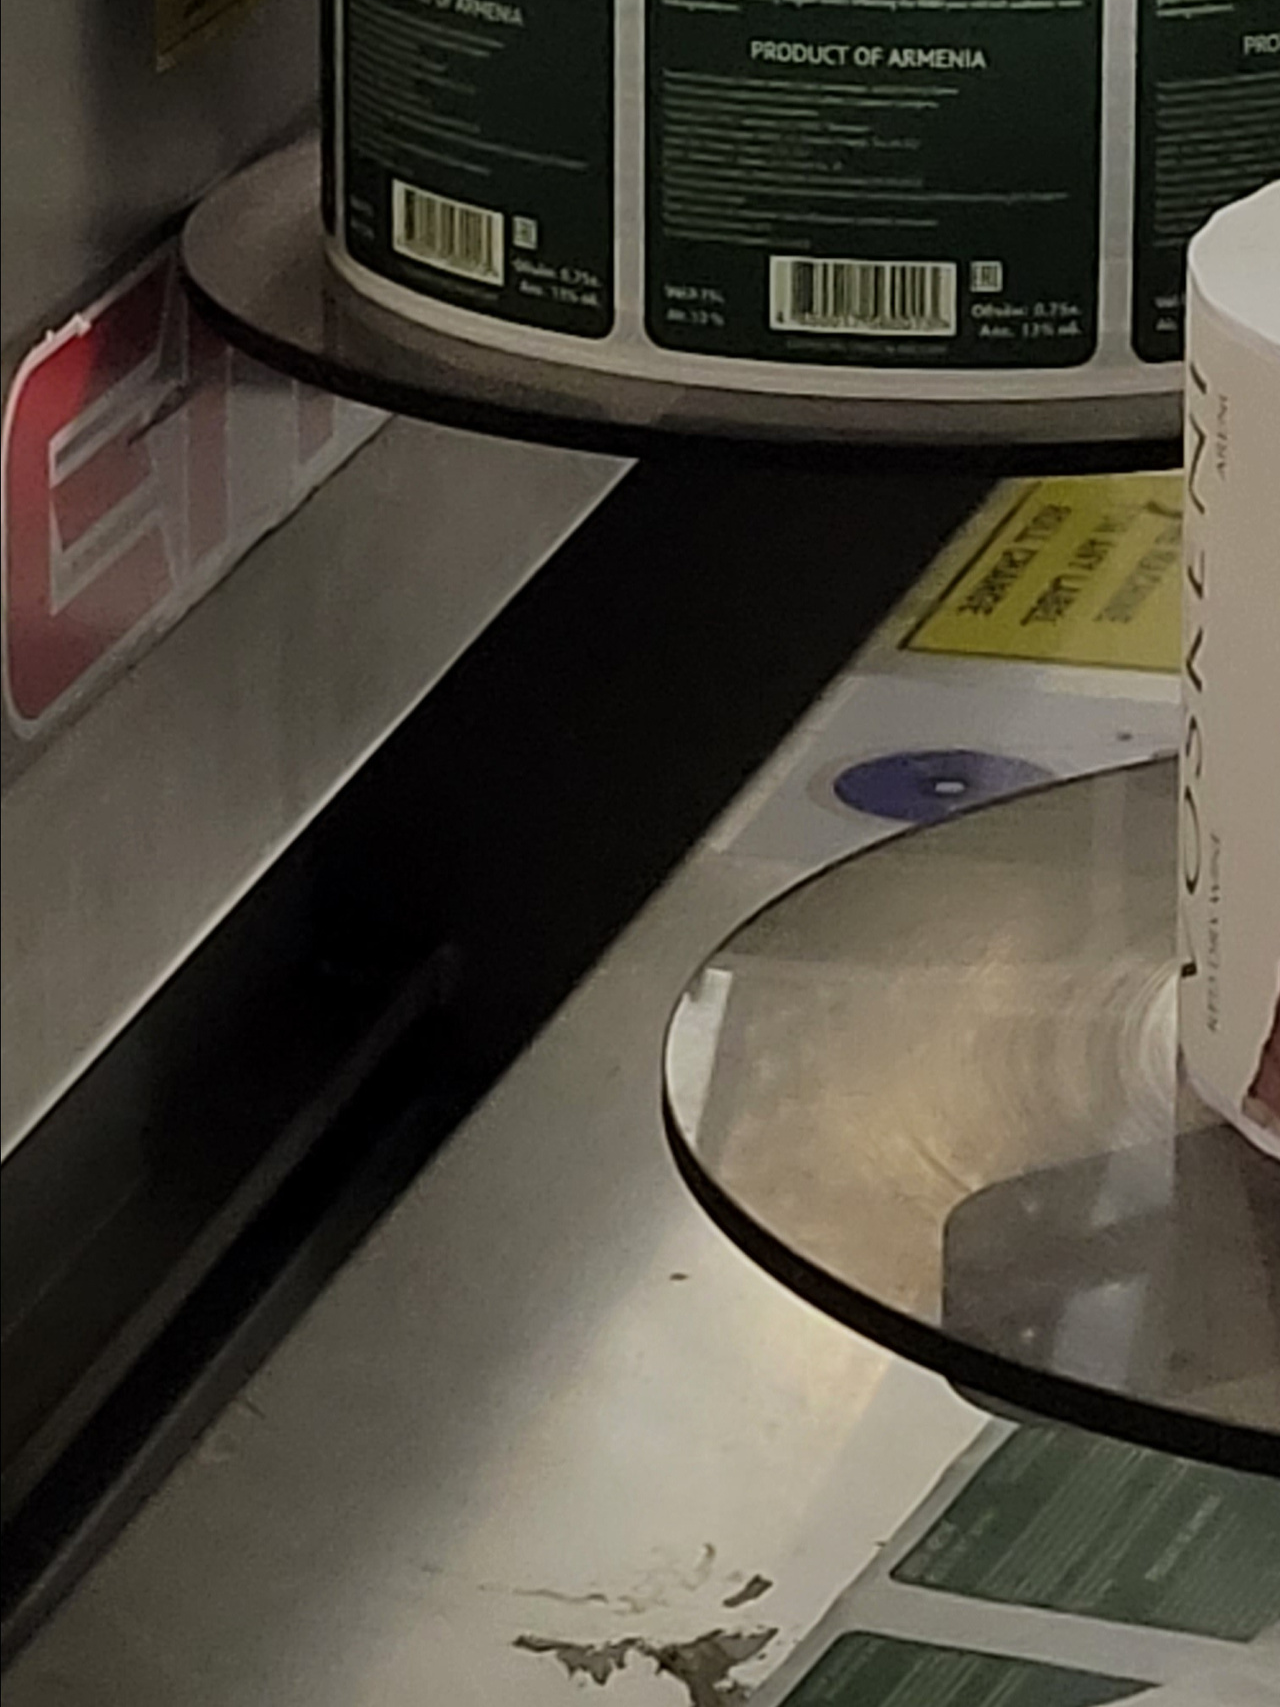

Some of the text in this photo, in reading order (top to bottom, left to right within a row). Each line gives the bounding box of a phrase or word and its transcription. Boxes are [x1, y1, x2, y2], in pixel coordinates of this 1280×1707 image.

[750, 40, 988, 70] PRODUCT OF ARMENIA
